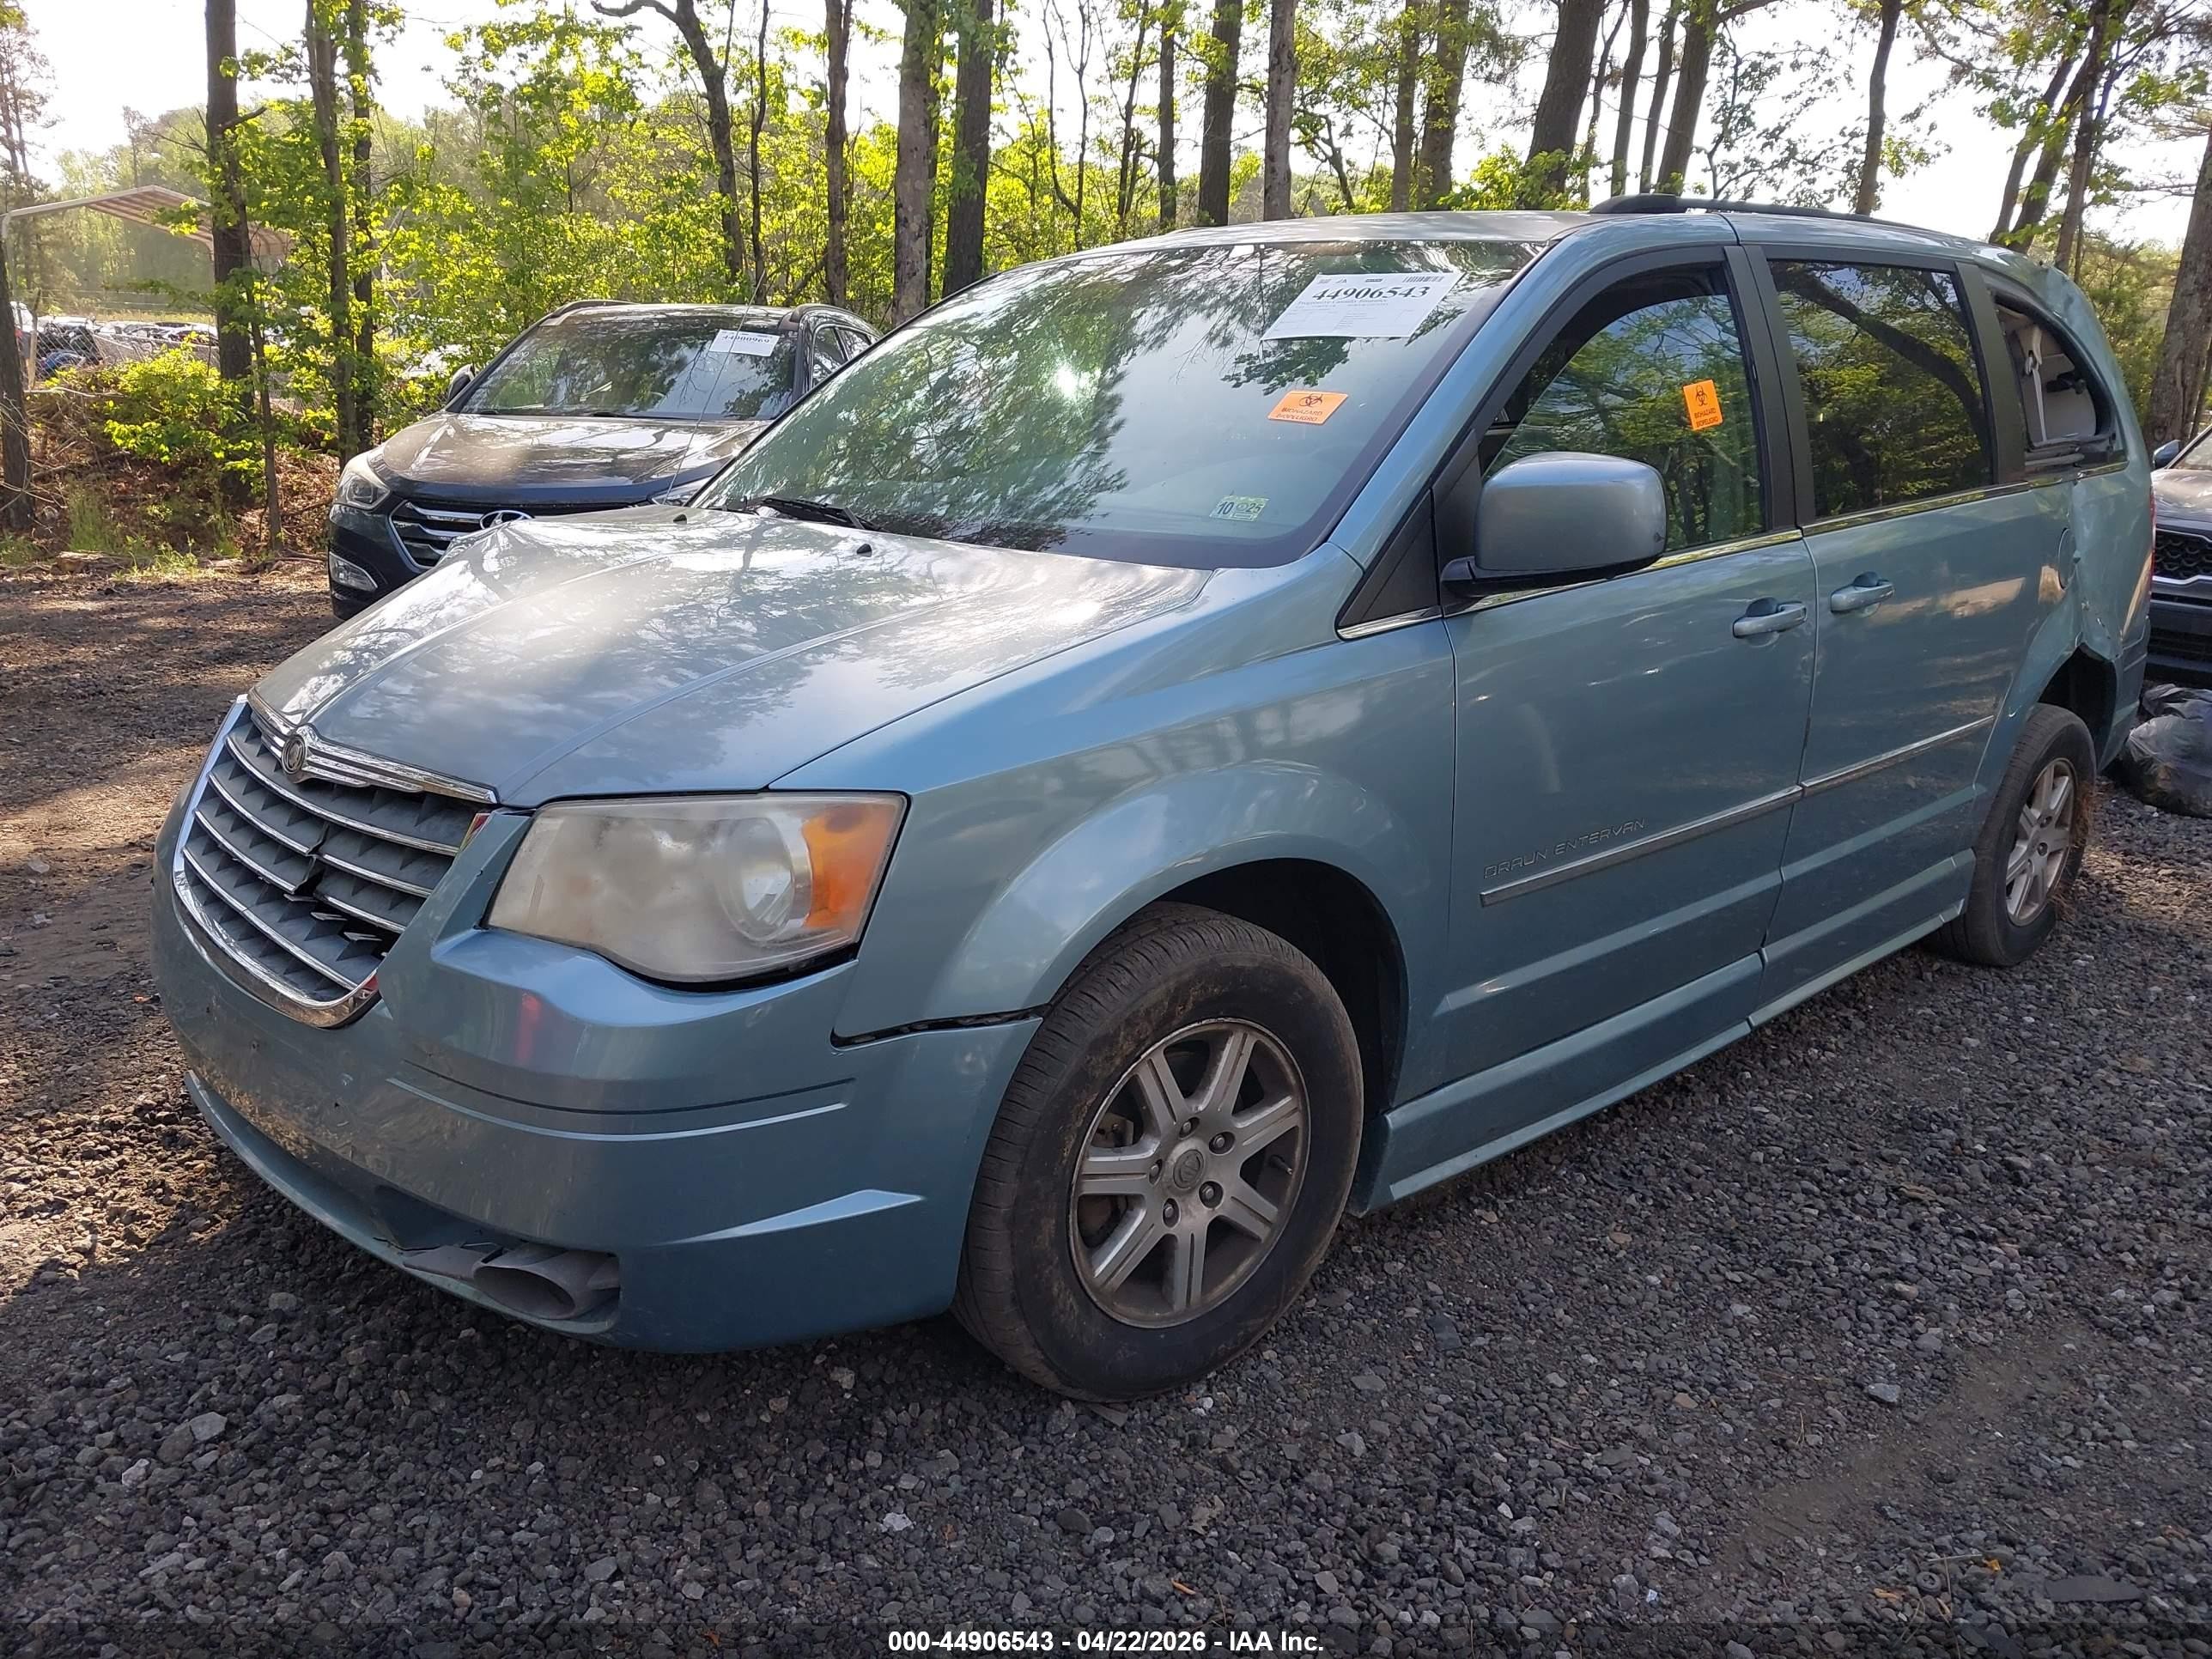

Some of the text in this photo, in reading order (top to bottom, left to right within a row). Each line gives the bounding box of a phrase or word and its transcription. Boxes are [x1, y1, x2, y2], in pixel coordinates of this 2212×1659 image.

[1312, 286, 1431, 301] 44906543
[1217, 501, 1235, 515] 10
[1245, 502, 1264, 514] 25
[1484, 817, 1645, 879] BRAUN ENTERVAN
